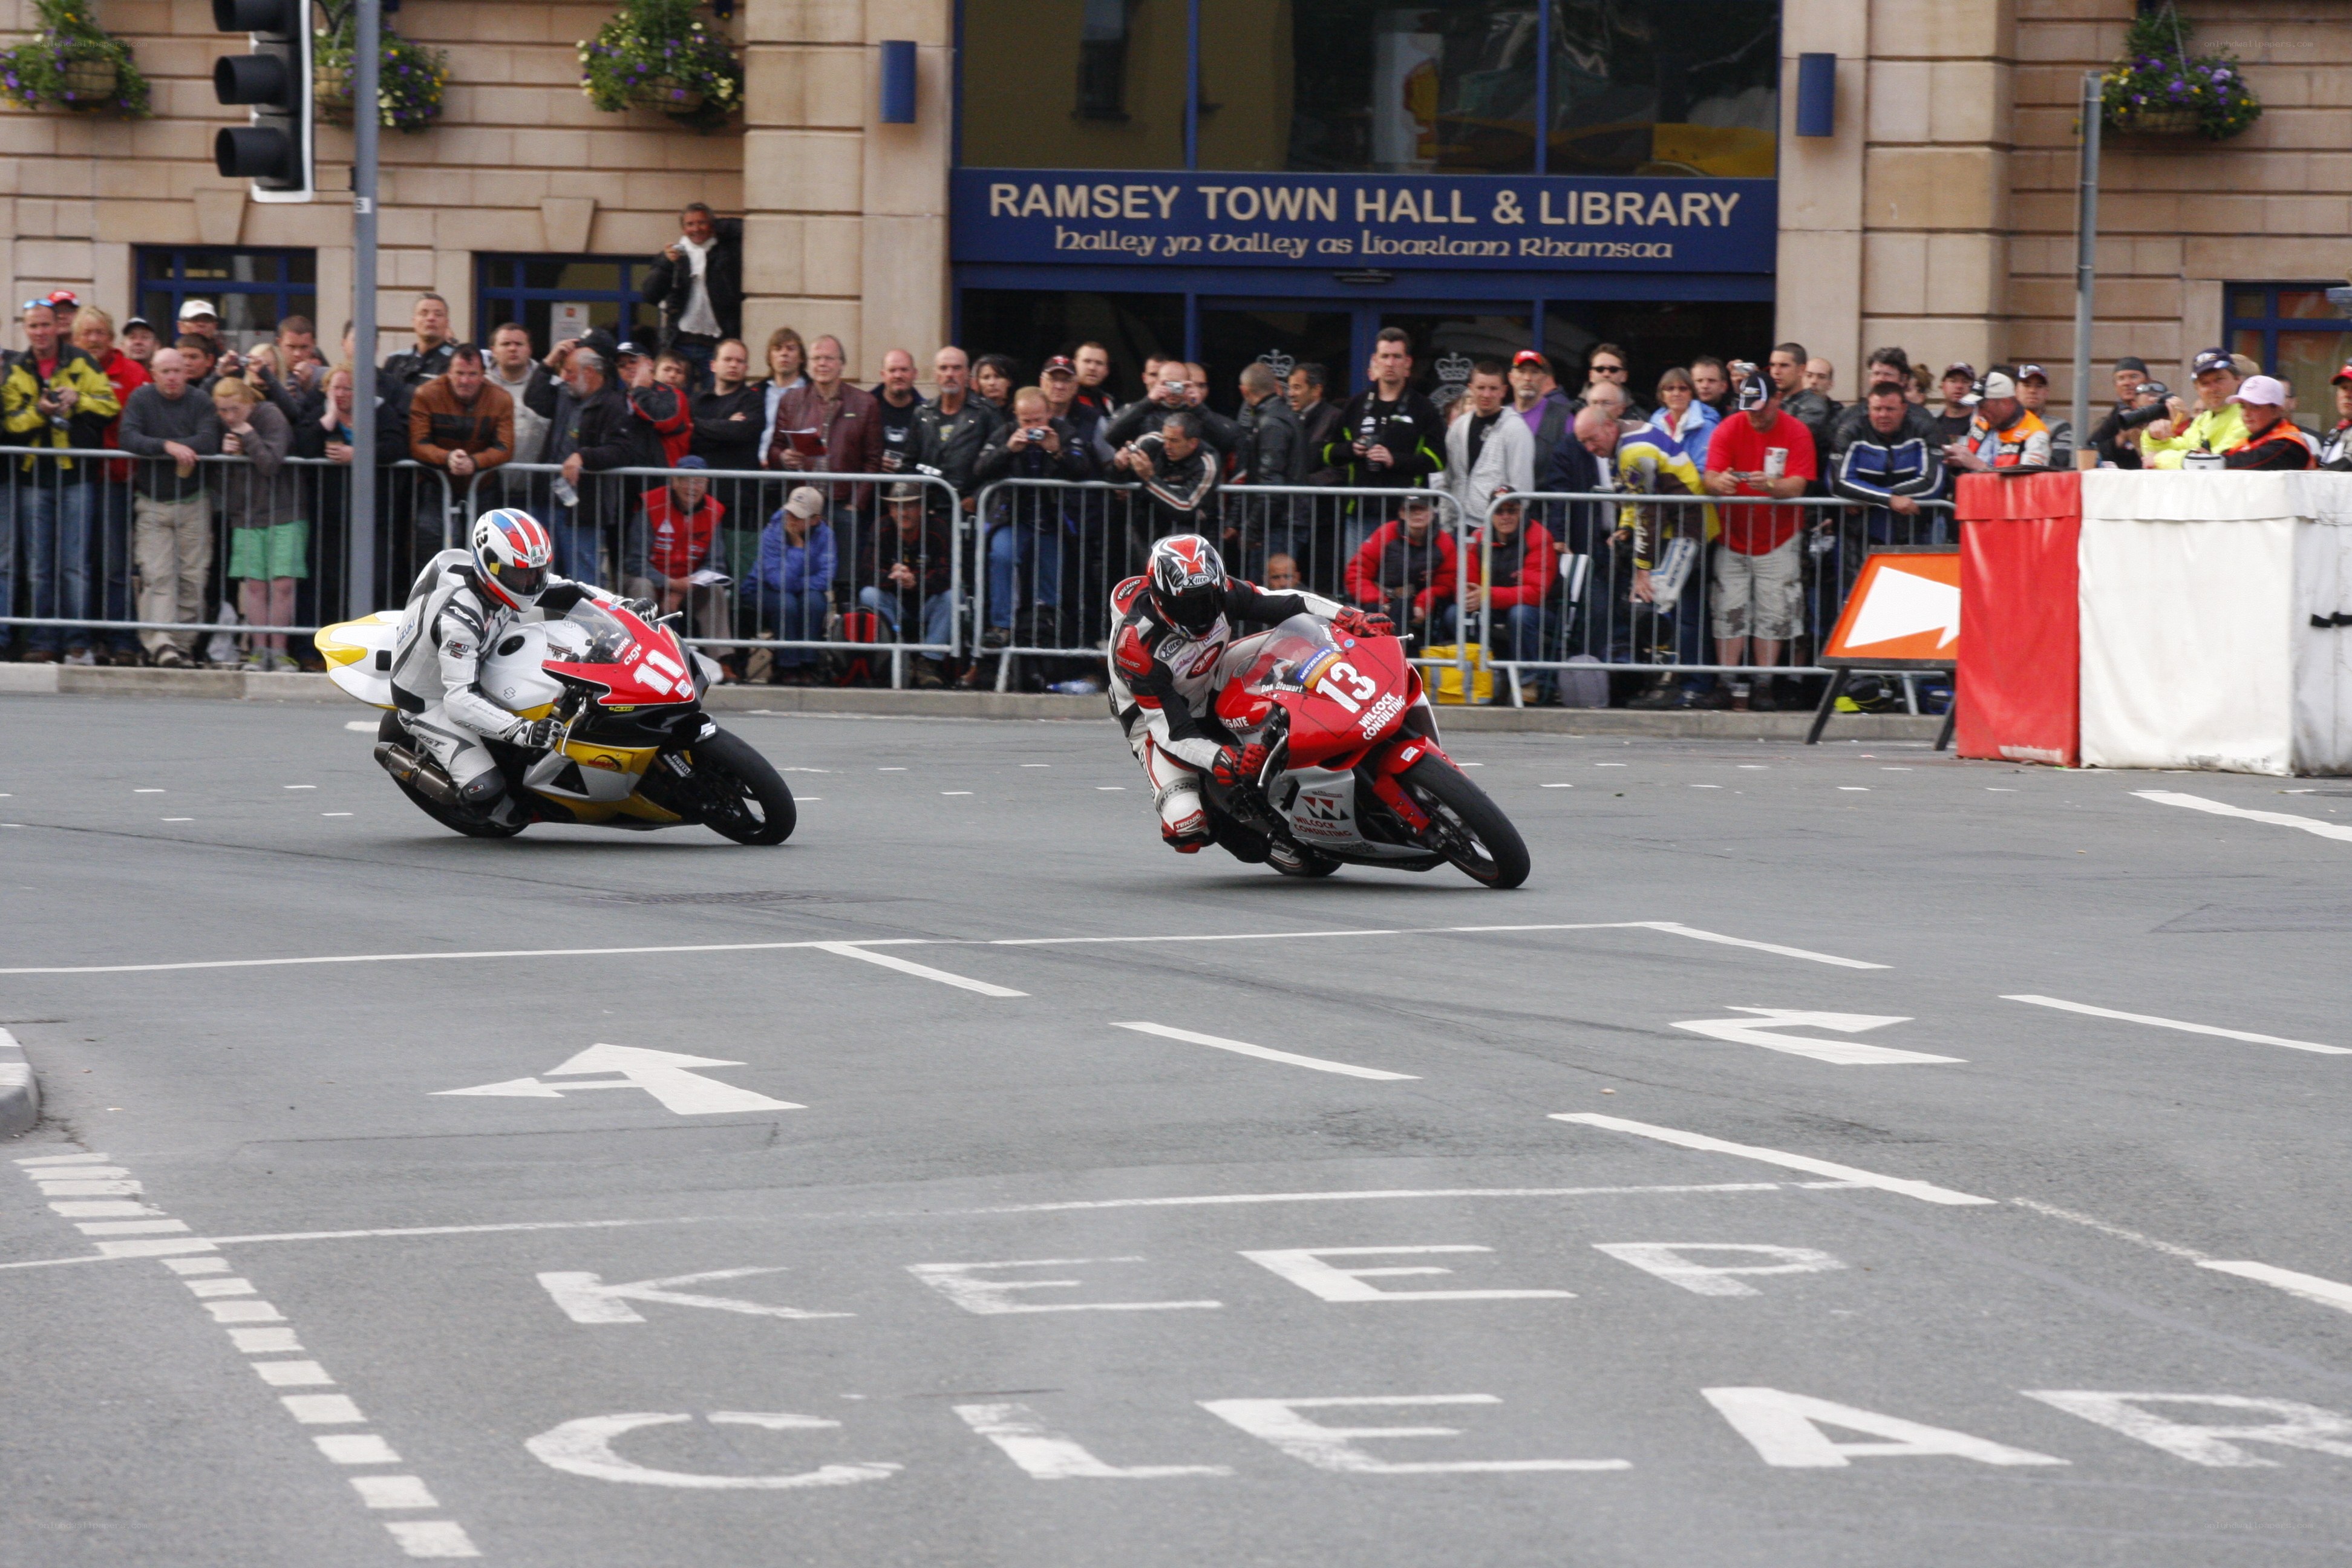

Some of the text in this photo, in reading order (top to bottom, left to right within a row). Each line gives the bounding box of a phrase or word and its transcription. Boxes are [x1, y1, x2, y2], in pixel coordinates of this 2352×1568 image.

[990, 183, 1741, 227] RAMSEY TOWN HALL & LIBRARY
[1162, 234, 1202, 256] yn
[1317, 234, 1353, 254] as
[1518, 237, 1674, 258] Rhumsaa
[1117, 579, 1142, 600] TEKNIC
[613, 637, 631, 659] MOTUL
[624, 643, 642, 665] agv
[633, 649, 685, 696] 11
[1300, 652, 1326, 681] METZELER
[1275, 681, 1304, 693] Stewart
[1316, 662, 1376, 714] 13
[1358, 691, 1396, 729] WILCOCK
[1362, 694, 1405, 740] CONSULTING
[417, 733, 448, 748] RST
[671, 754, 691, 774] PIRELLI
[1175, 813, 1201, 830] TEKNIC
[1293, 815, 1337, 829] WILCOCK
[1293, 824, 1353, 837] CONSULTING
[536, 1241, 1848, 1325] KEEP
[524, 1385, 2352, 1488] CLEAR
